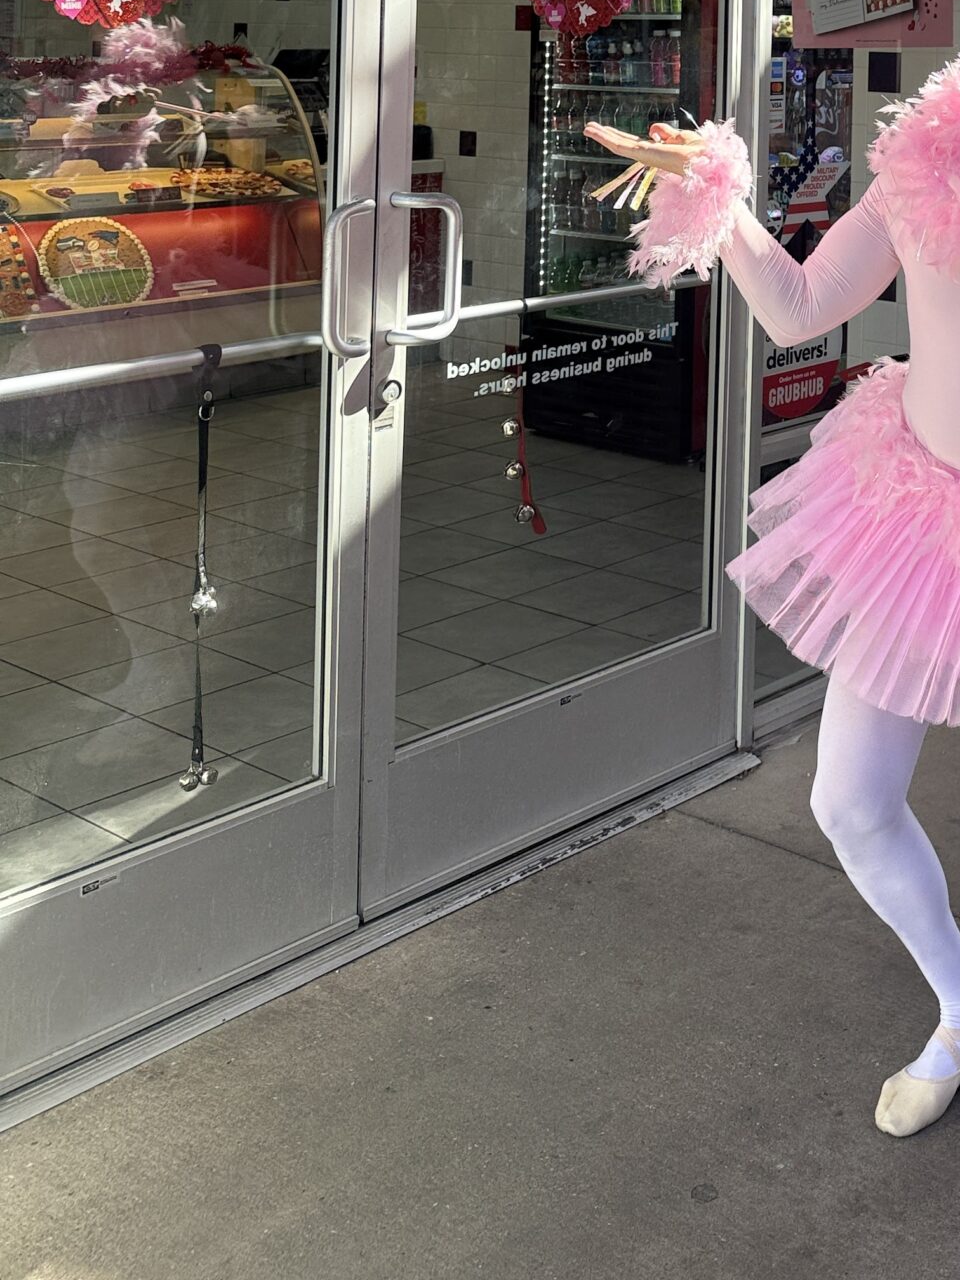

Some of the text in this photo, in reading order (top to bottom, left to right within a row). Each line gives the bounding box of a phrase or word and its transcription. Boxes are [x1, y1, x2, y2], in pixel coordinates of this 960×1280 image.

[816, 166, 840, 175] MILITARY
[811, 174, 836, 182] DISCOUNT
[803, 183, 826, 191] PROUDLY
[796, 191, 819, 199] OFFERED
[766, 337, 828, 369] delivers!
[768, 376, 824, 408] GRUBHUB
